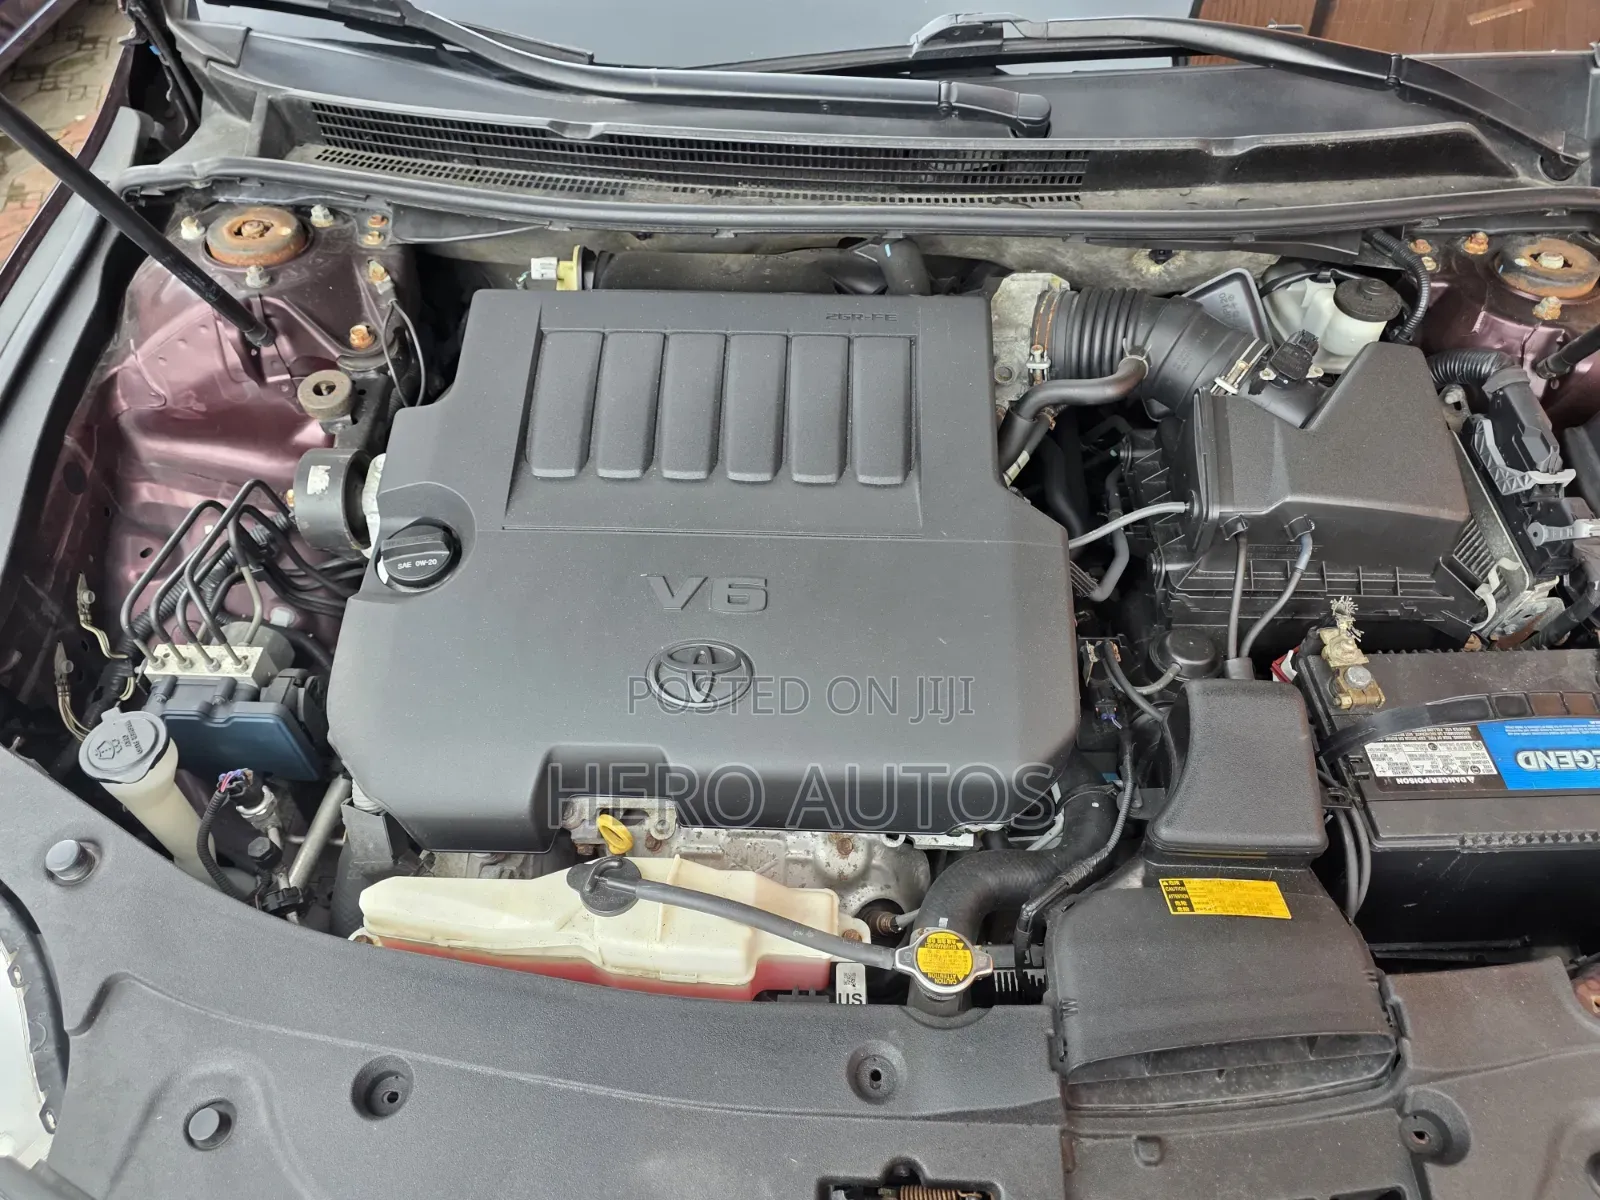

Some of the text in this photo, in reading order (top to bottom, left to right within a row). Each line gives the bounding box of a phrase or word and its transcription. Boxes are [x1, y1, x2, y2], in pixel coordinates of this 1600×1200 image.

[397, 558, 438, 570] SAE 0W-20
[645, 575, 769, 613] V6
